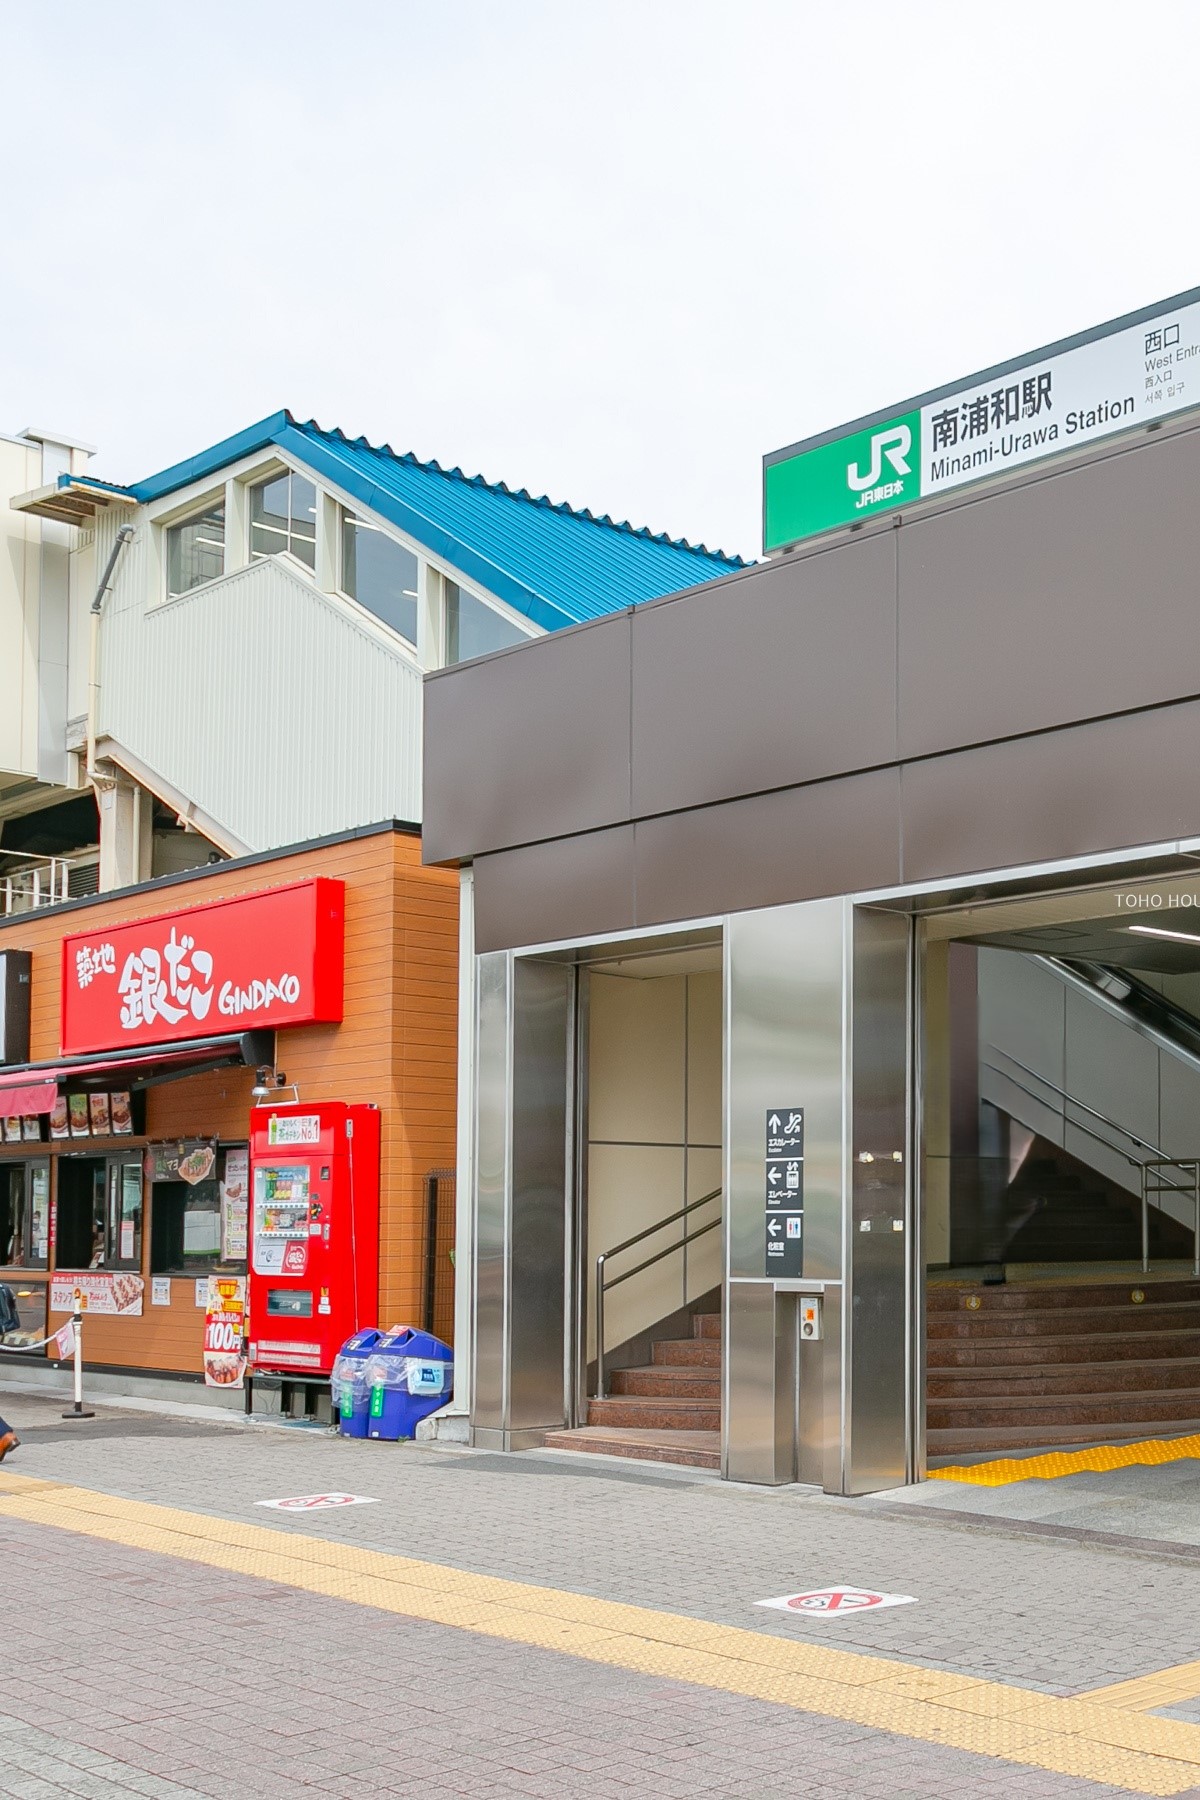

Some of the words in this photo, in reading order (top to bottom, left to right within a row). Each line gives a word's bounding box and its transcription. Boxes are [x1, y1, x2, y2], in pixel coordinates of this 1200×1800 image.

[1144, 323, 1180, 356] 西口
[1144, 353, 1173, 373] West
[1144, 369, 1173, 390] 西入口
[931, 371, 1052, 453] 南浦和駅
[930, 423, 1059, 482] Minami-Urawa
[1065, 395, 1135, 435] Station
[847, 424, 912, 491] JR
[855, 479, 904, 509] JR東日本
[76, 943, 116, 989] 築地
[118, 926, 214, 1029] 銀だこ
[218, 973, 300, 1016] GINDACO
[768, 1137, 801, 1147] エスカレーター
[768, 1190, 798, 1199] エレベーター
